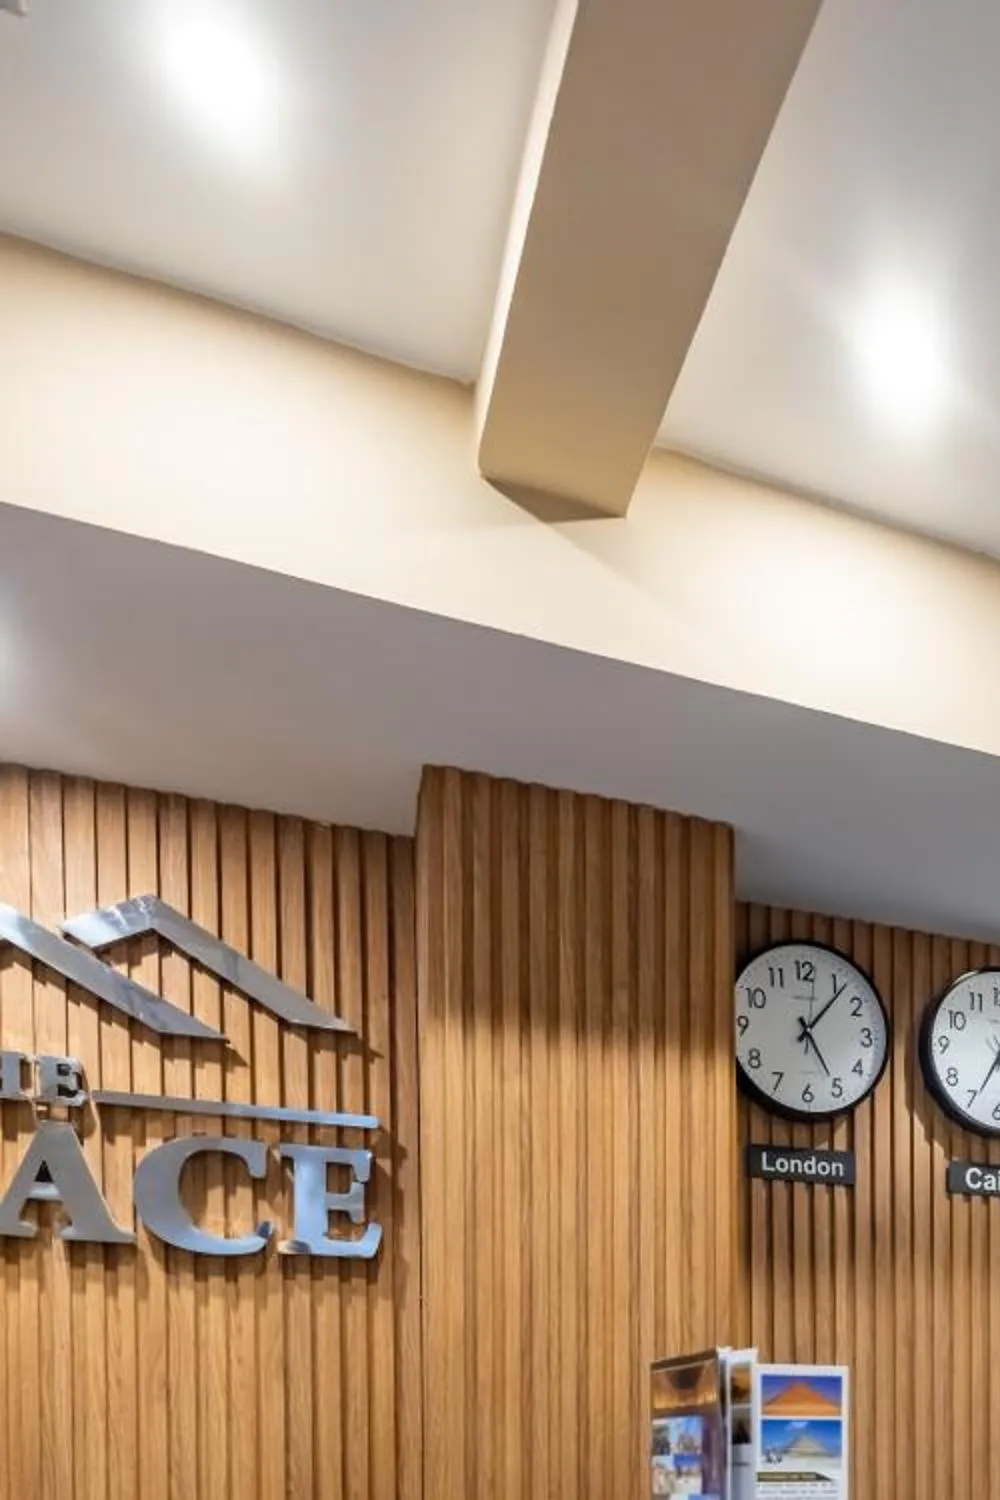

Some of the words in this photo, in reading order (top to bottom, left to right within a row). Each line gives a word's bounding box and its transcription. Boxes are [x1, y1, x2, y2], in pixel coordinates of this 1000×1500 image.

[768, 967, 784, 988] 11
[795, 960, 815, 982] 12
[832, 974, 838, 994] 1
[746, 987, 766, 1009] 10
[850, 997, 862, 1017] 2
[970, 992, 983, 1012] 11
[737, 1016, 749, 1036] 9
[949, 1010, 966, 1030] 10
[860, 1028, 873, 1048] 3
[938, 1035, 949, 1054] 9
[748, 1048, 761, 1069] 8
[852, 1058, 863, 1077] 4
[772, 1072, 784, 1091] 7
[946, 1067, 958, 1086] 8
[802, 1084, 814, 1103] 6
[832, 1078, 843, 1098] 5
[968, 1090, 977, 1109] 7
[761, 1152, 844, 1177] London
[0, 1120, 383, 1259] ACE
